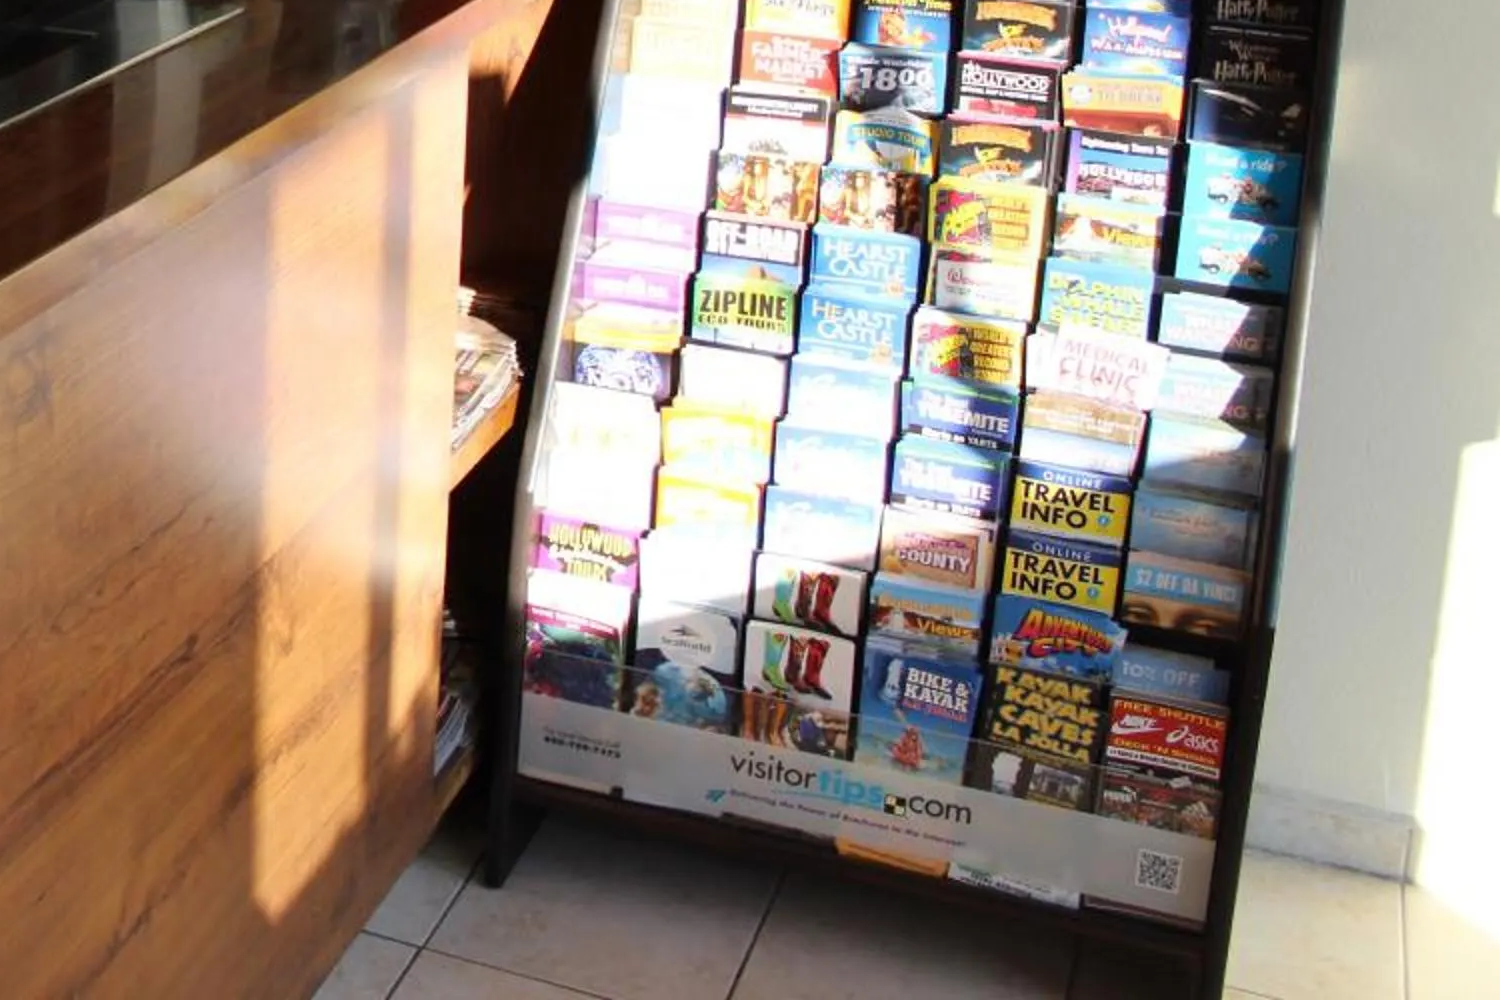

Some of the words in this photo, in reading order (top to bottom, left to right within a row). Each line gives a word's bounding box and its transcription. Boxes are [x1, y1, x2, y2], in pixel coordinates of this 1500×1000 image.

[962, 65, 1051, 92] HOLLYWOOD
[1214, 58, 1253, 82] Harry
[823, 239, 911, 265] HEARST
[829, 256, 907, 282] CASTLE
[699, 288, 788, 321] ZIPLINE
[812, 298, 898, 329] HEARST
[816, 320, 894, 344] CASTLE
[1064, 339, 1150, 375] MEDICAL
[1059, 357, 1141, 396] CLINIC
[1043, 471, 1103, 489] ONLINE
[1021, 479, 1116, 513] TRAVEL
[1021, 501, 1088, 529] INFO
[549, 522, 633, 560] HOLLYWOOD
[1032, 542, 1092, 563] ONLINE
[897, 550, 972, 574] COUNTY
[1010, 551, 1104, 585] TRAVEL
[1010, 571, 1077, 600] INFO
[1156, 572, 1179, 590] OFF
[661, 632, 712, 654] SeaWorld
[917, 618, 975, 641] Views
[908, 667, 953, 692] BIKE
[955, 682, 969, 698] &
[997, 667, 1091, 704] KAYAK
[1163, 669, 1201, 687] OFF
[904, 682, 968, 713] KAYAK
[1004, 685, 1098, 726] KAYAK
[1000, 703, 1095, 745] CAVES
[1114, 699, 1152, 714] FREE
[1158, 707, 1226, 728] SHUTTLE
[1120, 713, 1158, 729] NIKE
[993, 722, 1021, 741] LA
[1026, 733, 1090, 764] JOLLA
[1184, 732, 1220, 753] asics
